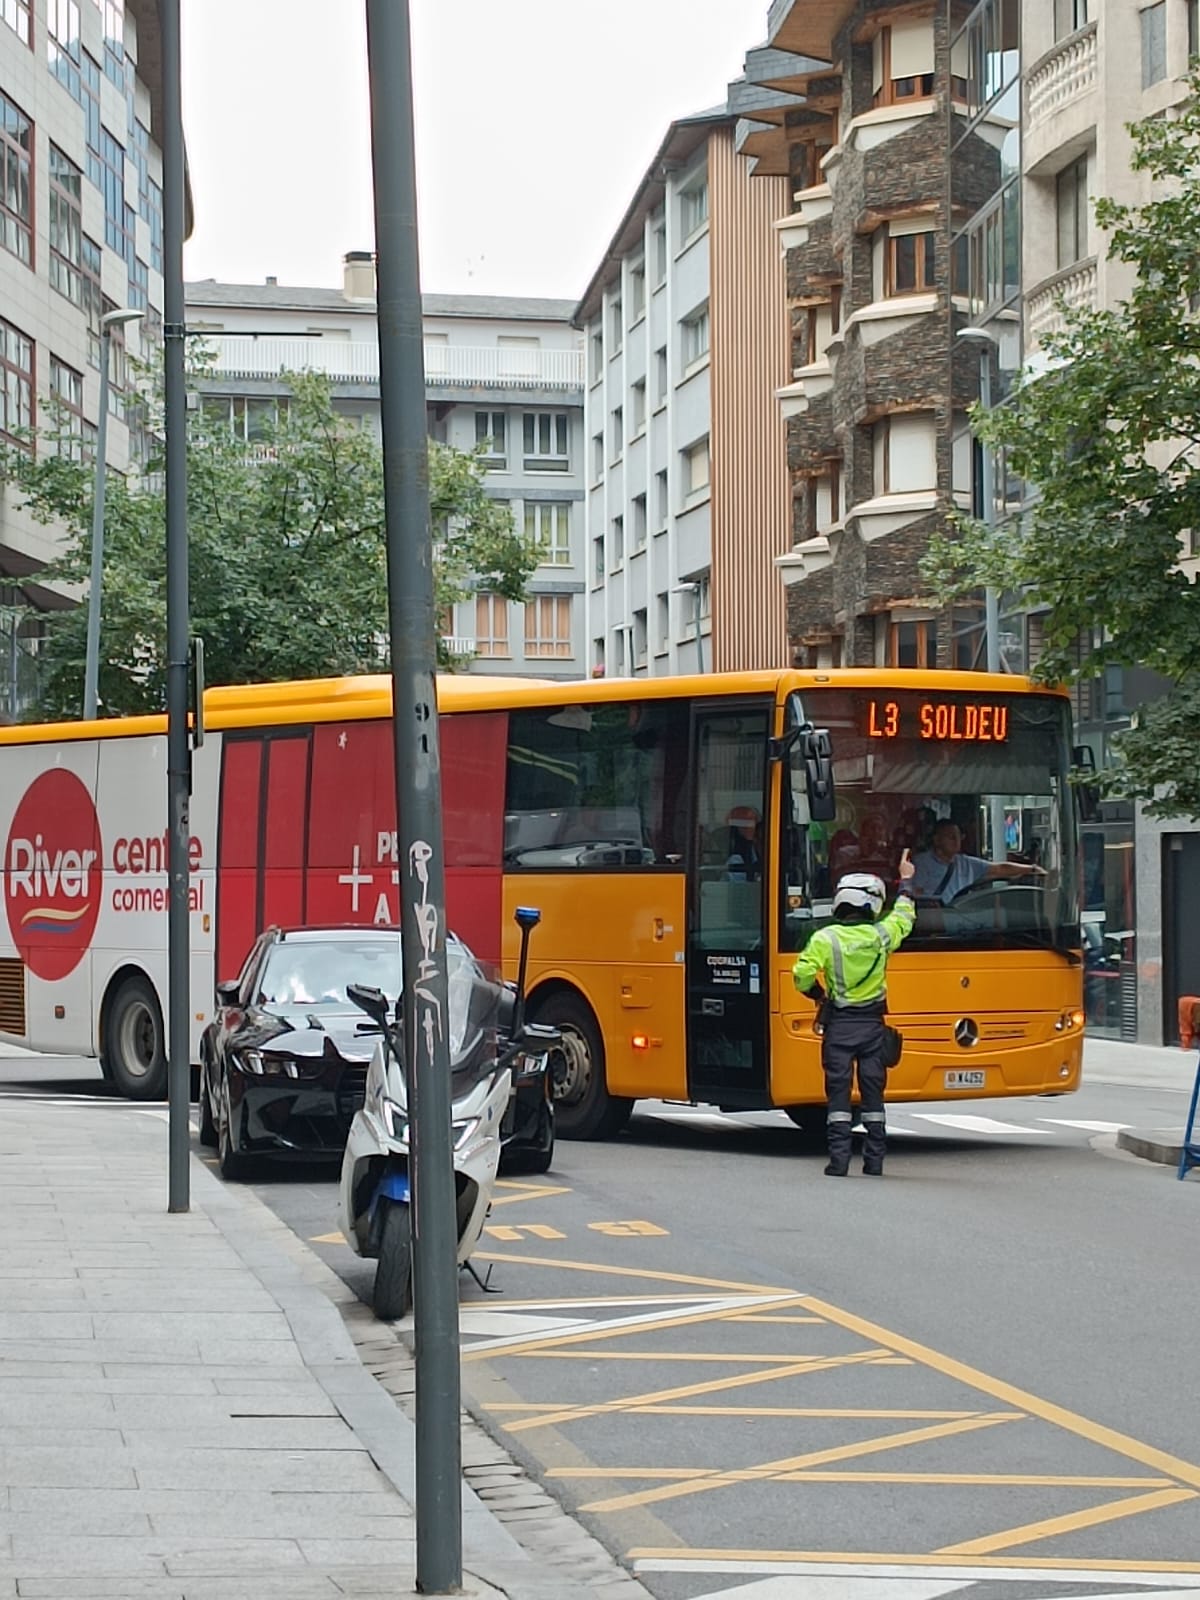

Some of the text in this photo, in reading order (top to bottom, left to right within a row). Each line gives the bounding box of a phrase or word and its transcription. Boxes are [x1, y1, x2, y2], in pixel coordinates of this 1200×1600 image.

[869, 702, 1007, 740] L3 SOLDEU
[10, 834, 97, 897] River
[112, 828, 203, 873] cente
[112, 879, 204, 912] comeral
